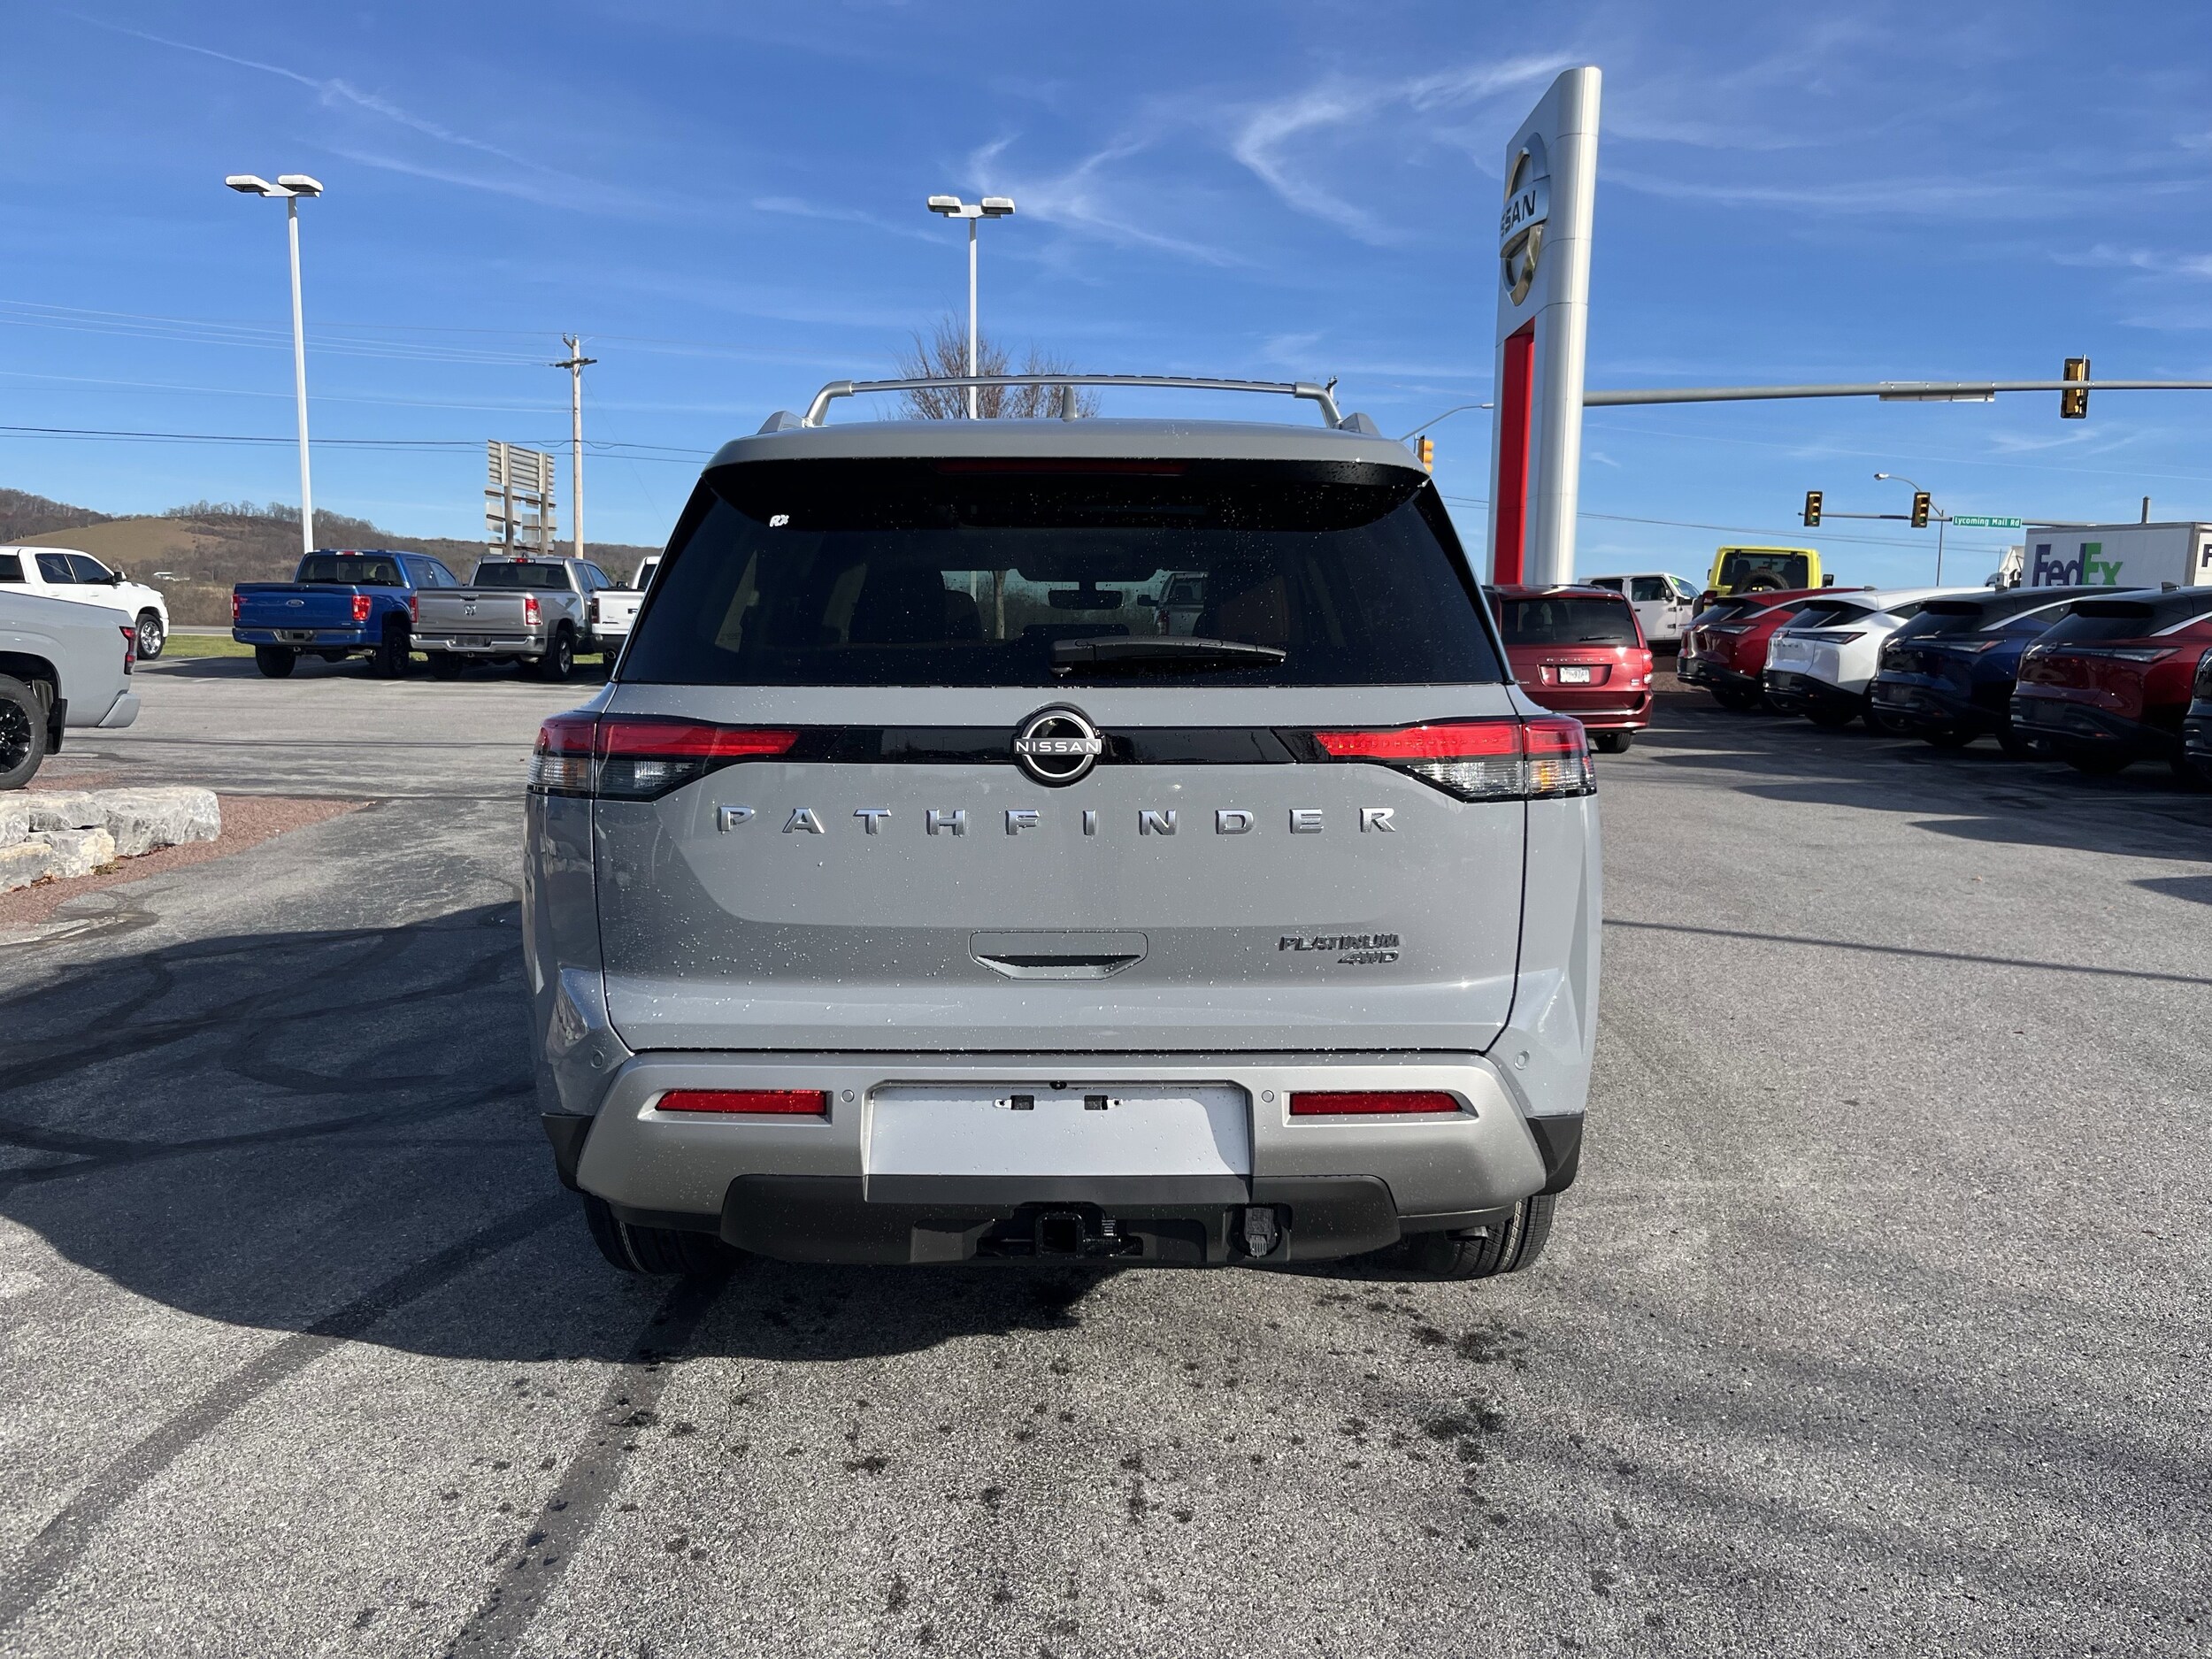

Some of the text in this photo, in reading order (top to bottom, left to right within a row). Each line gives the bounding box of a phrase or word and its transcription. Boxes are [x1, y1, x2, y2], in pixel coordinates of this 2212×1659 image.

[1955, 517, 2020, 527] Lycoming Mall Rd
[2032, 542, 2124, 588] FedEx
[1016, 741, 1099, 753] NISSAN
[717, 804, 1396, 837] PATHFINDER
[1279, 933, 1400, 951] PLATINUM
[1337, 949, 1400, 964] 4WD
